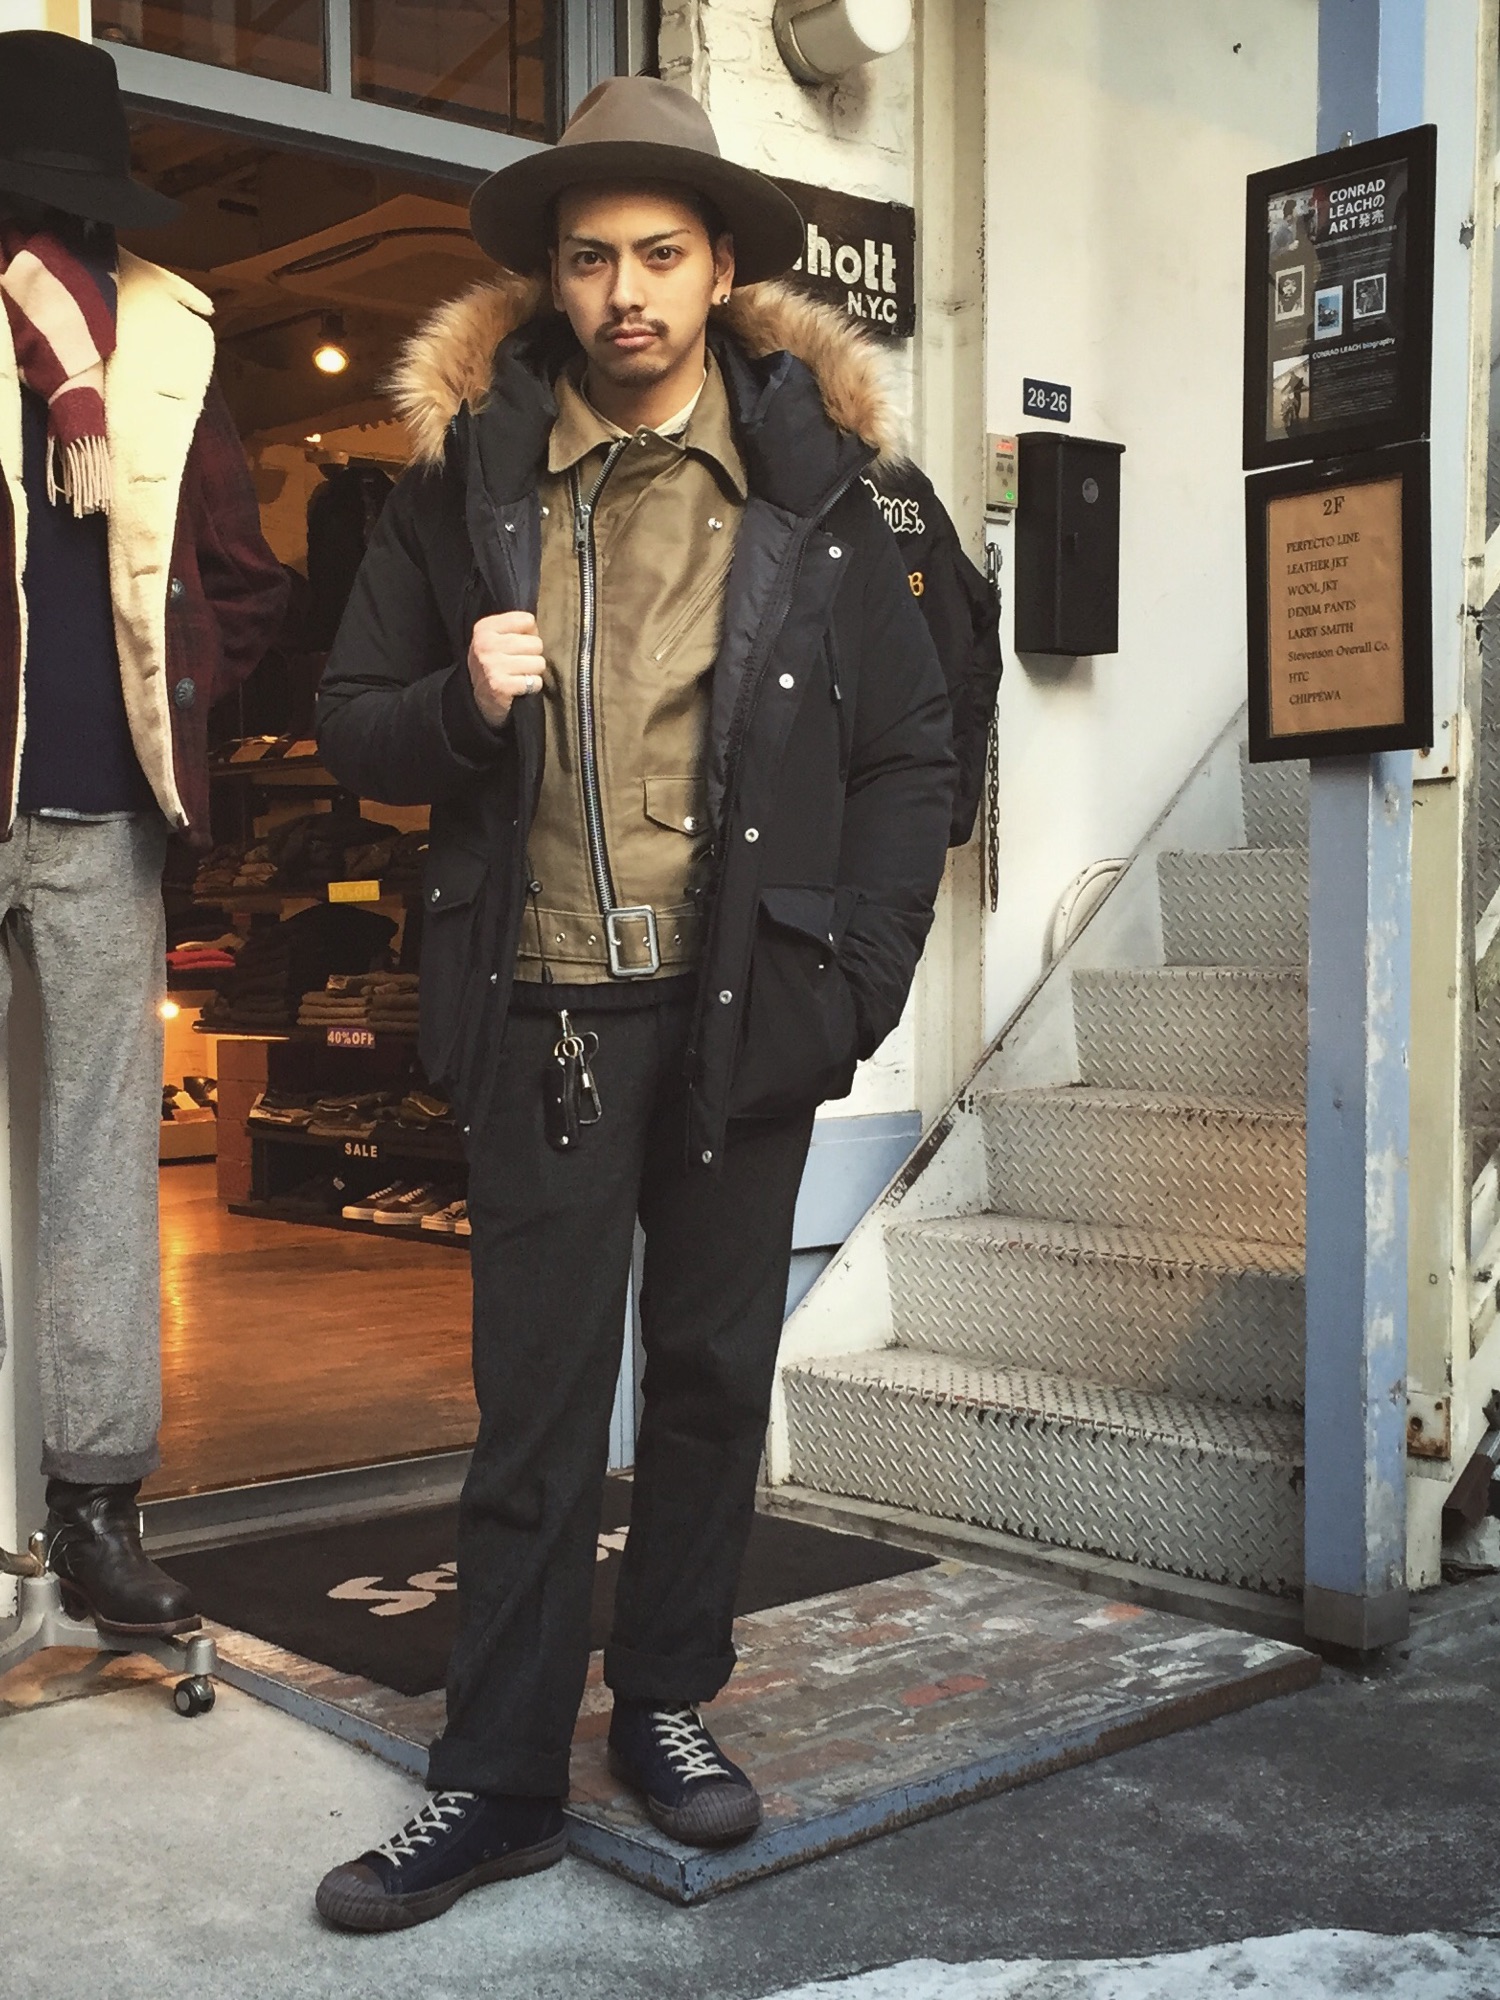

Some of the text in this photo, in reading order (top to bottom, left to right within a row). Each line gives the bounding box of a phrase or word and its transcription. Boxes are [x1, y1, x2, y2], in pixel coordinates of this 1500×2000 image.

[1330, 179, 1386, 203] CONRAD
[1329, 194, 1385, 219] LEACHの
[1329, 209, 1385, 235] ART発売
[792, 223, 897, 294] hott
[1312, 337, 1396, 360] CONRAD LEACH biography
[1028, 387, 1067, 413] 28-26
[1323, 495, 1345, 516] 2F
[1286, 532, 1361, 553] PERFECTO LINE
[1287, 556, 1348, 575] LEATHER JKT
[1287, 579, 1338, 596] WOOL JKT
[1287, 599, 1356, 619] DENIM PANTS
[1288, 622, 1353, 640] LARRY SMITH
[1288, 640, 1390, 662] Stevenson Overall Co.
[1289, 671, 1310, 683] HTC
[1289, 690, 1341, 705] CHIPPEWA
[345, 1142, 378, 1158] SALE
